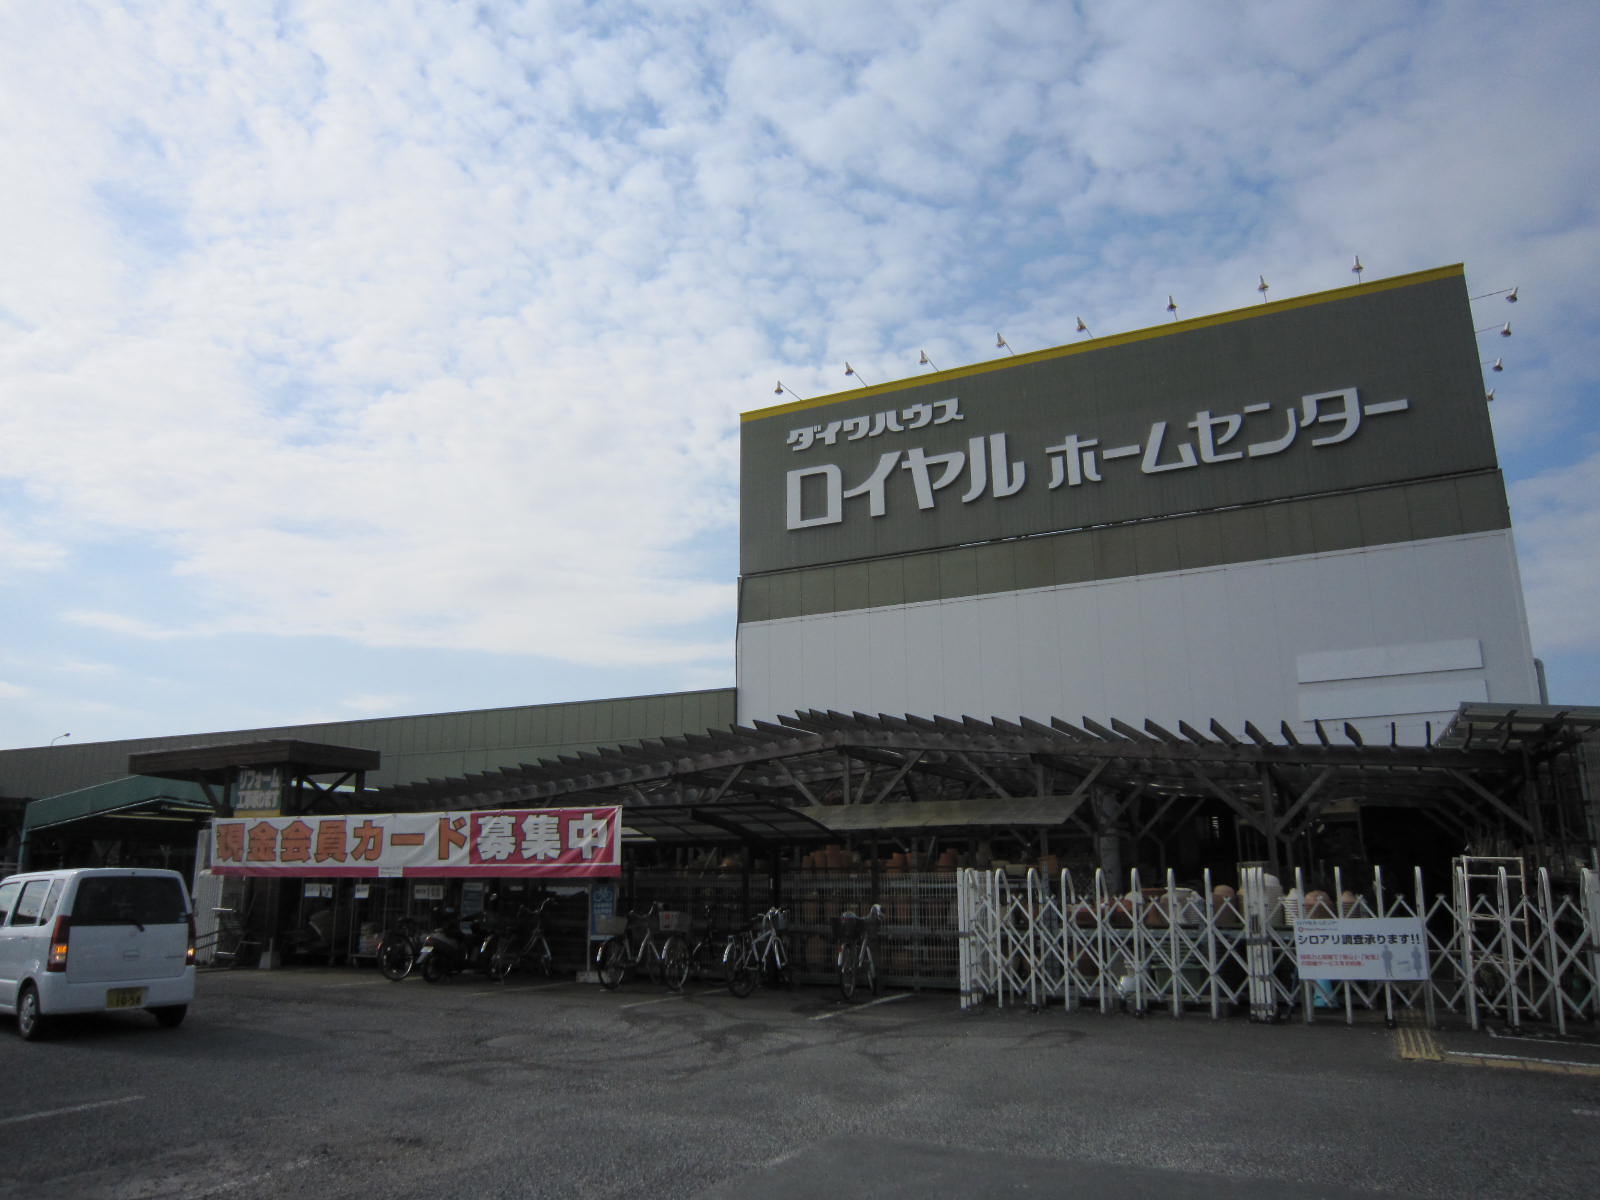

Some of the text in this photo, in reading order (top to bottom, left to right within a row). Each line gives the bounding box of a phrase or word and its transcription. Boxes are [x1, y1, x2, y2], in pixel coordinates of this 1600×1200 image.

[786, 397, 965, 450] ダイワハウス
[786, 387, 1409, 530] ロイヤル ホームセンター
